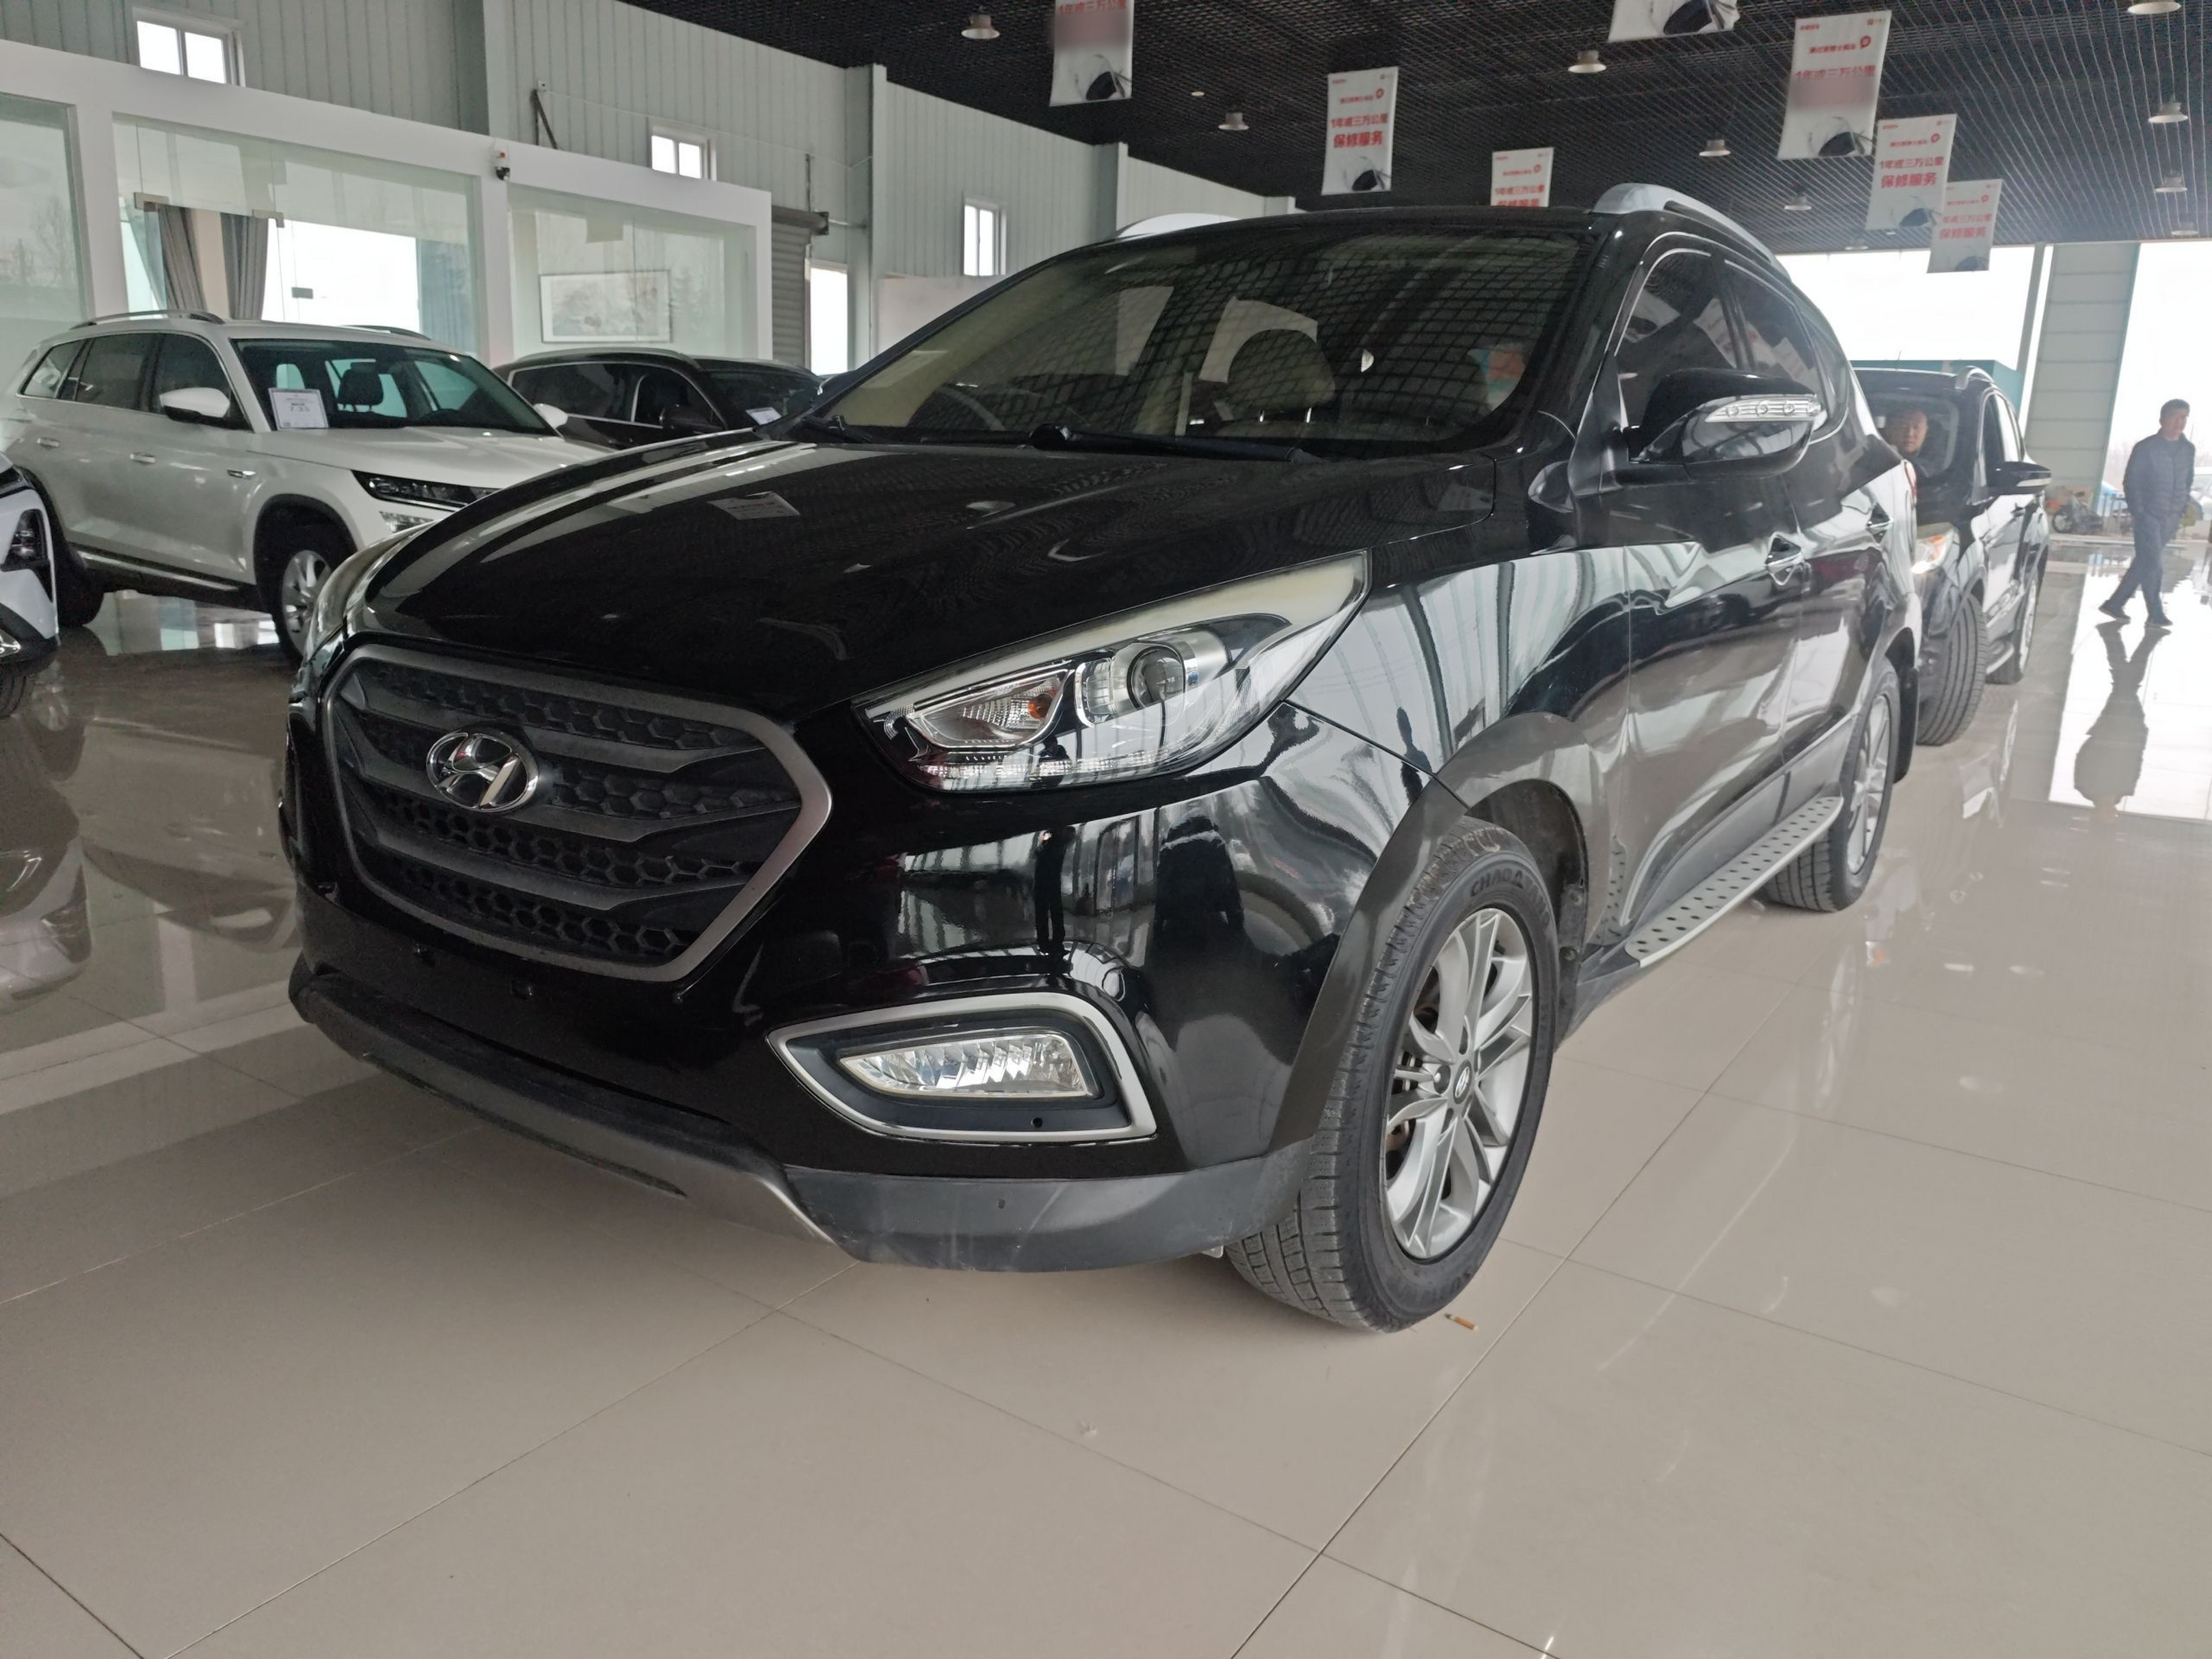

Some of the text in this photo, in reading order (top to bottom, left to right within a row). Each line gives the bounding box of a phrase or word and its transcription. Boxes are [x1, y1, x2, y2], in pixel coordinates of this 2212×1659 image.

[1334, 130, 1382, 148] 保修服务
[1881, 172, 1936, 188] 保修服务
